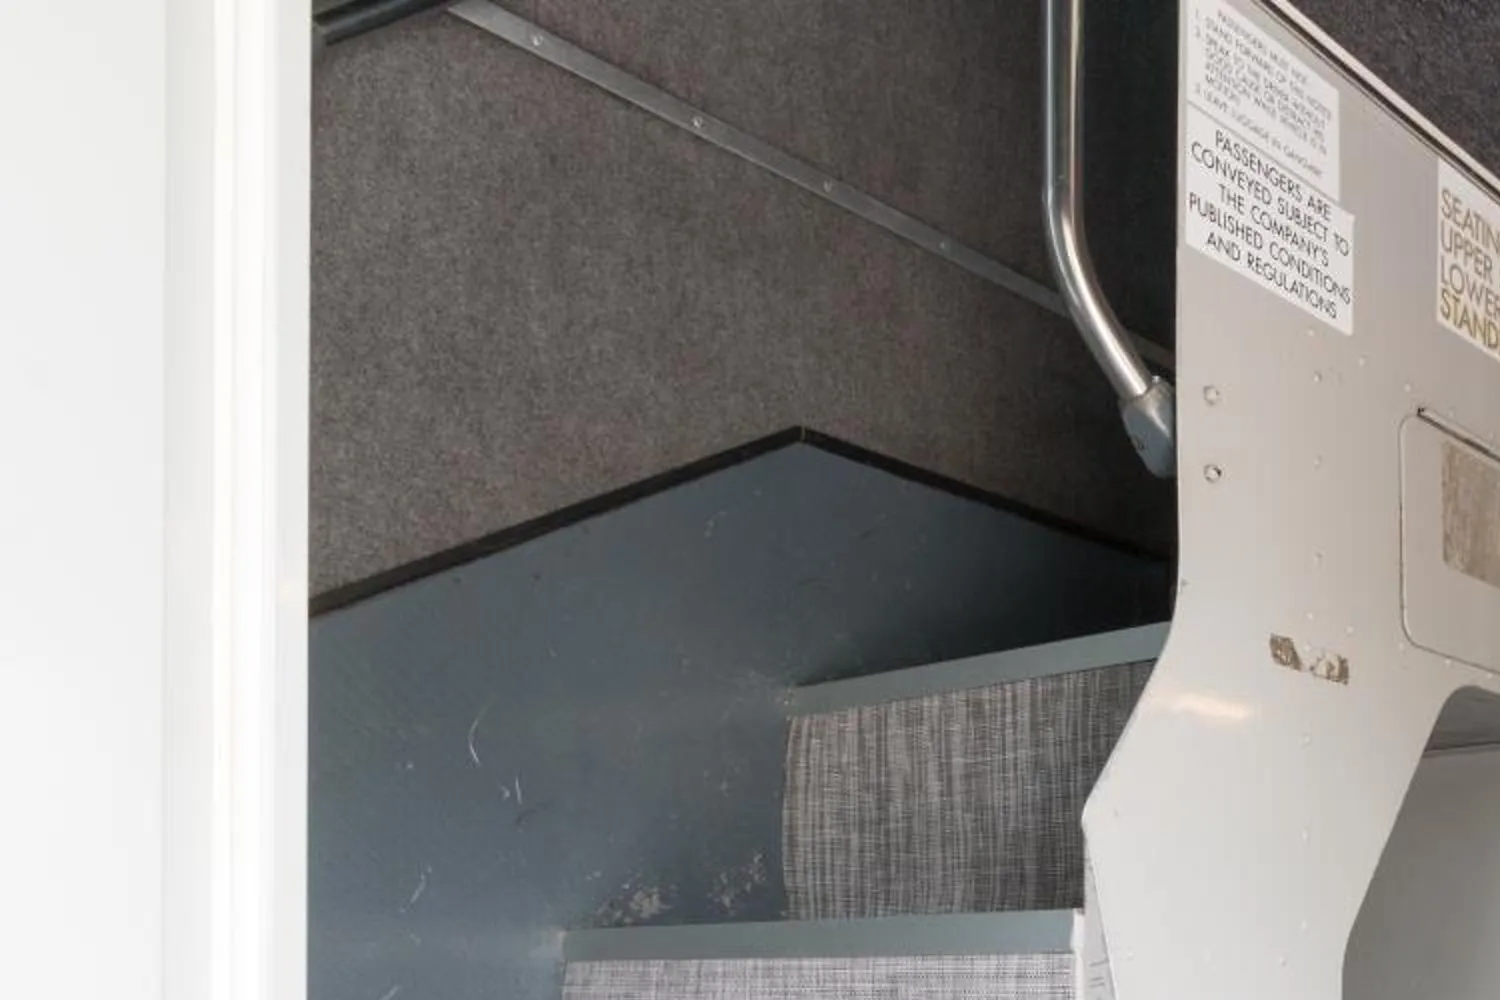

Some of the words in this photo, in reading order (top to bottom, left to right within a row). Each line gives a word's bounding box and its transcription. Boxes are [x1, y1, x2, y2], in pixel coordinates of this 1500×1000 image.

[1191, 142, 1272, 205] CONVEYED
[1278, 197, 1328, 242] SUBJECT
[1334, 232, 1349, 256] TO
[1216, 131, 1302, 200] PASSENGERS
[1308, 196, 1331, 221] ARE
[1189, 192, 1263, 250] PUBLISHED
[1269, 241, 1351, 304] CONDITIONS
[1218, 184, 1245, 215] THE
[1250, 206, 1328, 267] COMPANY'S
[1440, 220, 1493, 283] UPPER
[1207, 232, 1241, 261] AND
[1247, 252, 1336, 319] REGULATIONS
